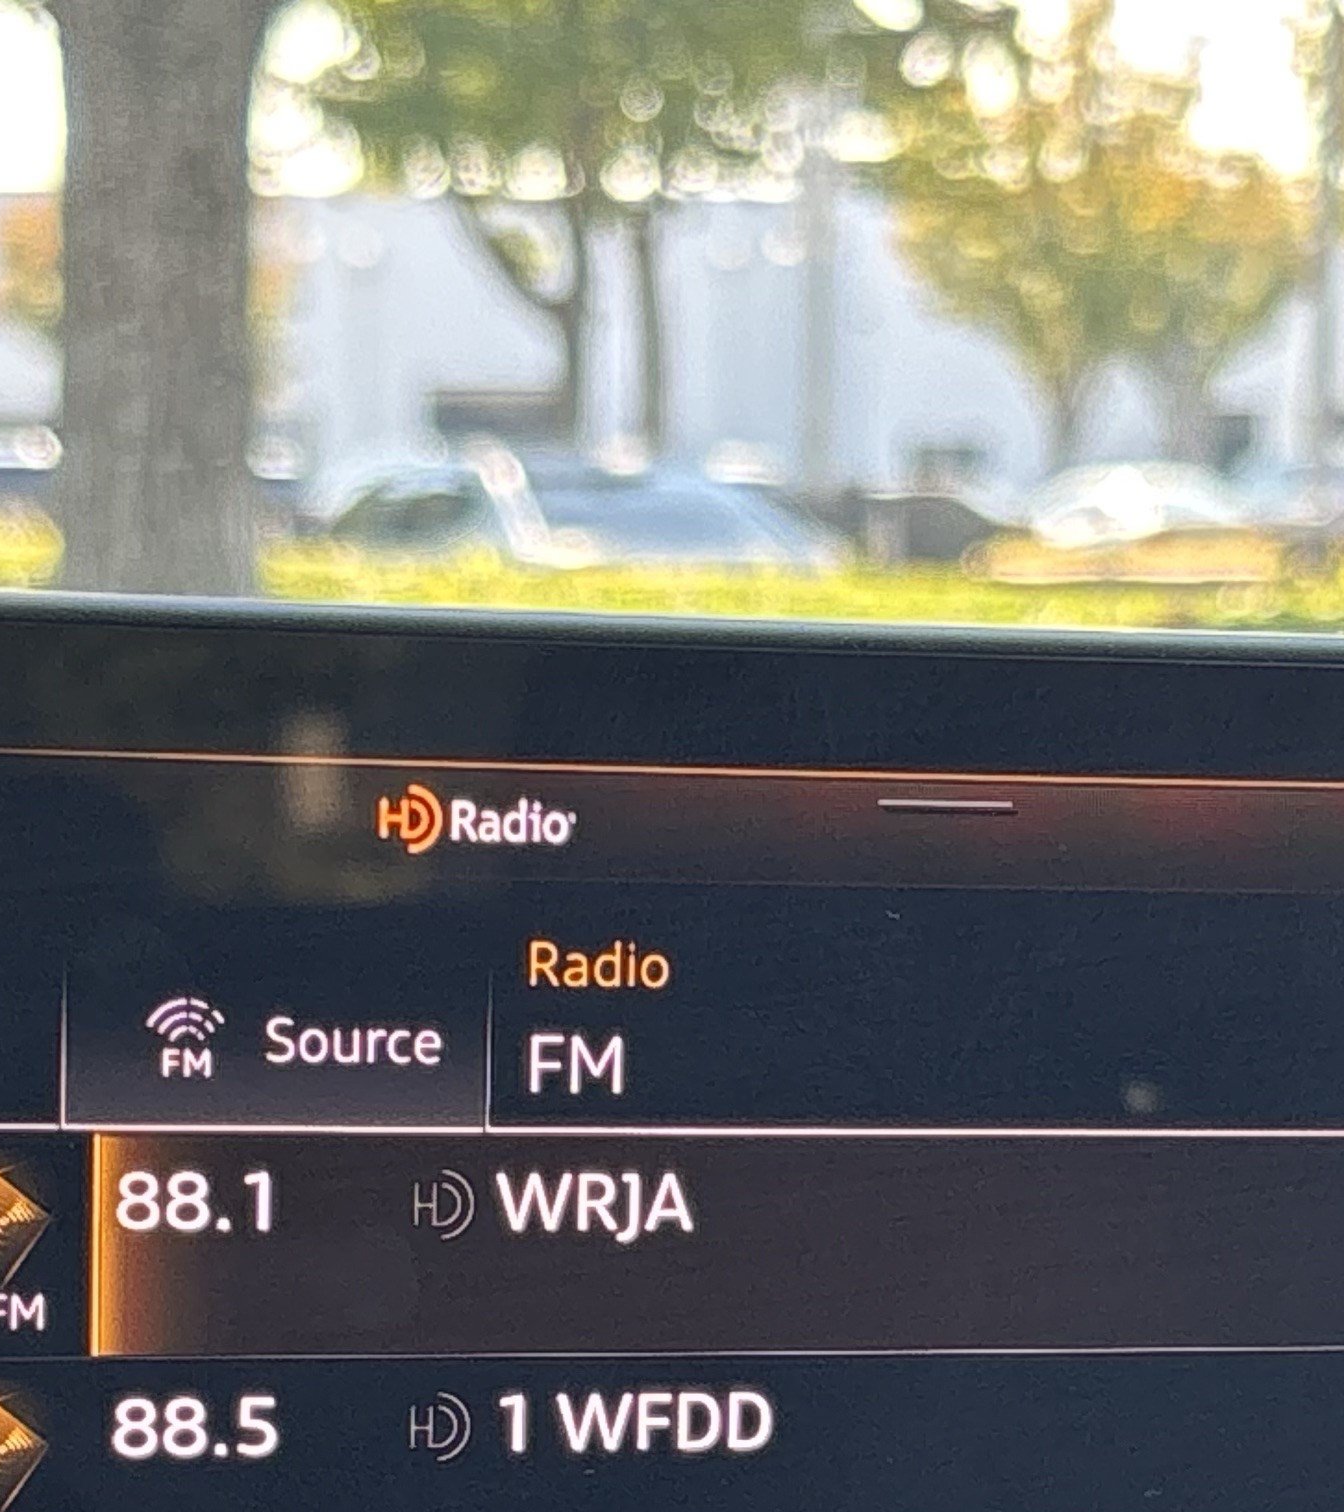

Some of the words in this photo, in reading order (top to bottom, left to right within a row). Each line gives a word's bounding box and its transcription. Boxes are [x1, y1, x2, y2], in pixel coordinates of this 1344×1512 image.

[378, 784, 443, 854] HD
[529, 940, 670, 989] Radio
[160, 1047, 213, 1079] FM
[265, 1016, 443, 1065] Source
[529, 1033, 624, 1095] FM
[115, 1171, 273, 1233] 88.1
[495, 1172, 694, 1244] WRJA
[111, 1395, 278, 1459] 88.5
[499, 1392, 527, 1453] 1
[555, 1391, 773, 1453] WFDD
